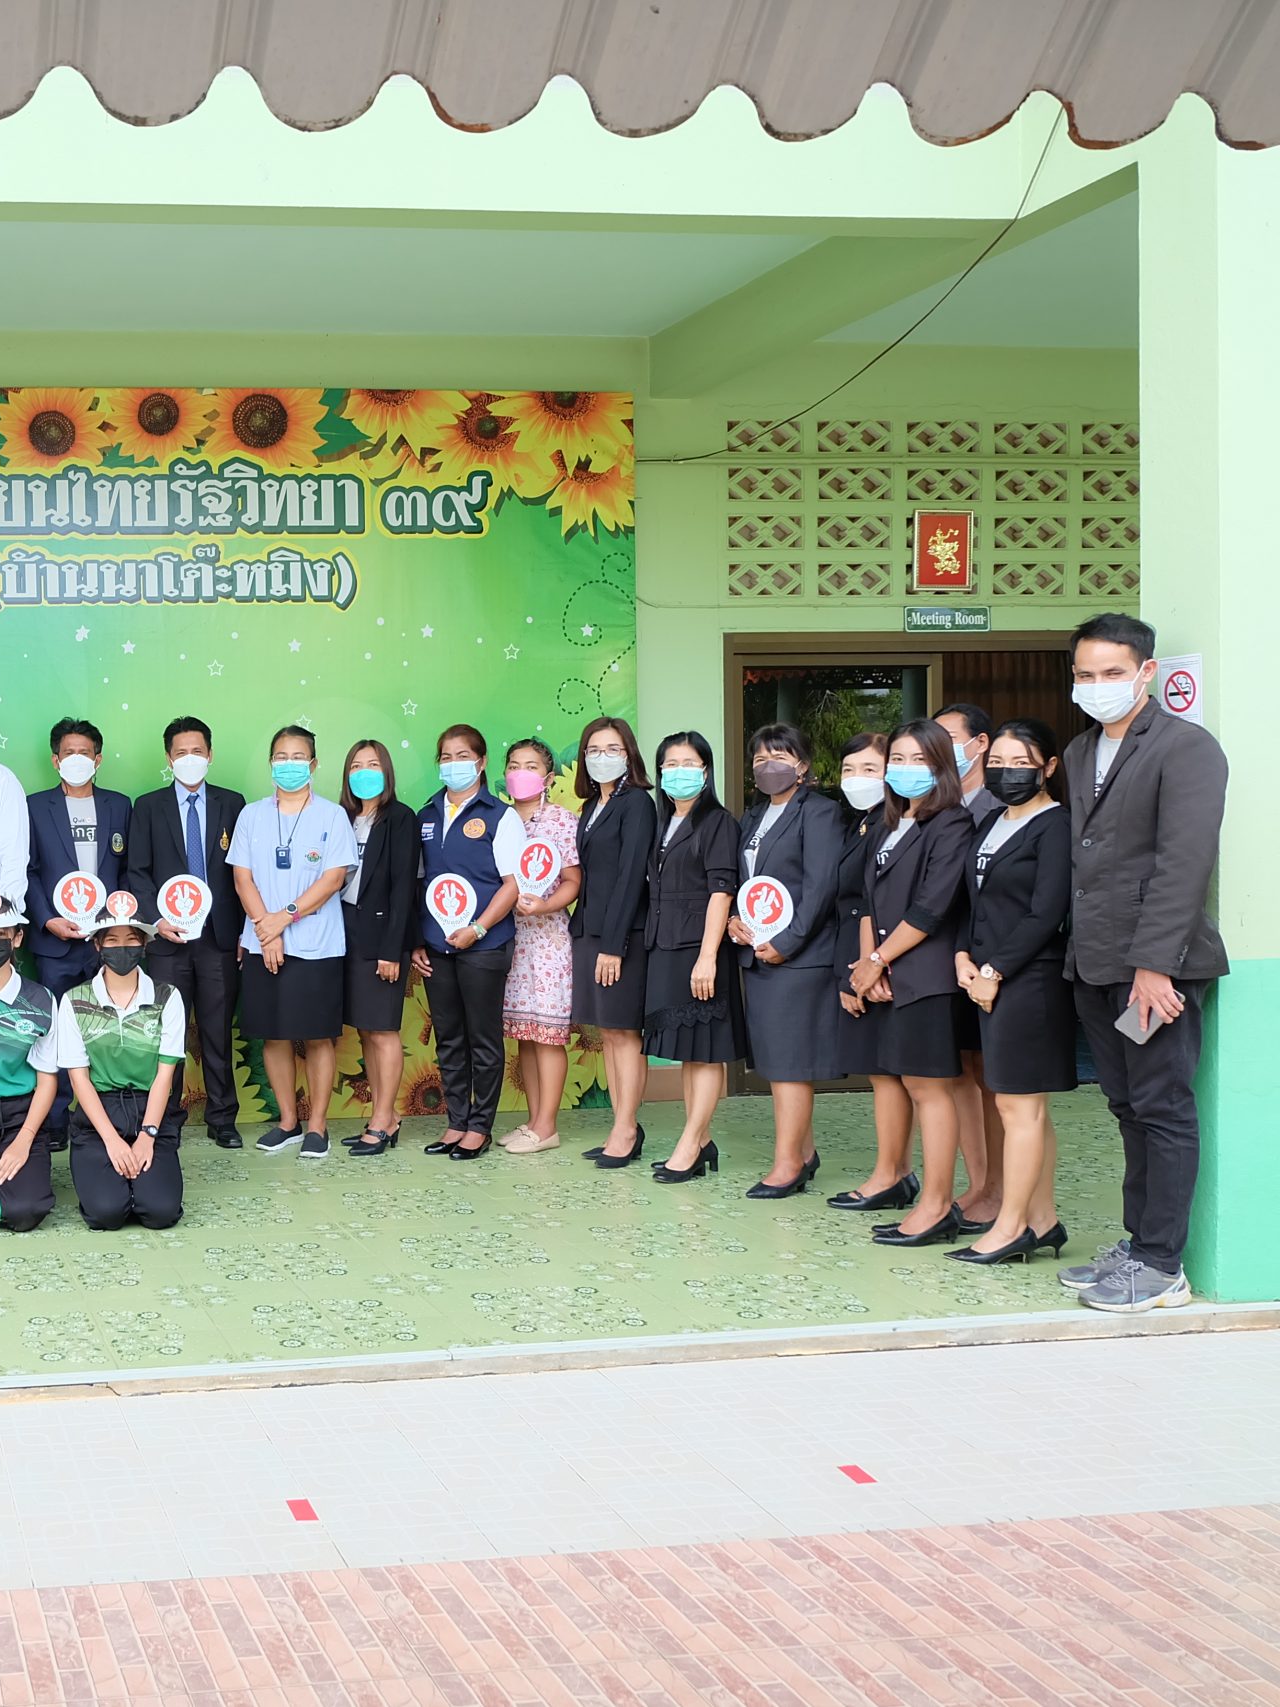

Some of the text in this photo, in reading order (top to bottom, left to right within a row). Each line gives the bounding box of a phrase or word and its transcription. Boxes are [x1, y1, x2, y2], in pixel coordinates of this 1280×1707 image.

[383, 475, 488, 529] ๓๙
[911, 611, 985, 629] Meeting Room
